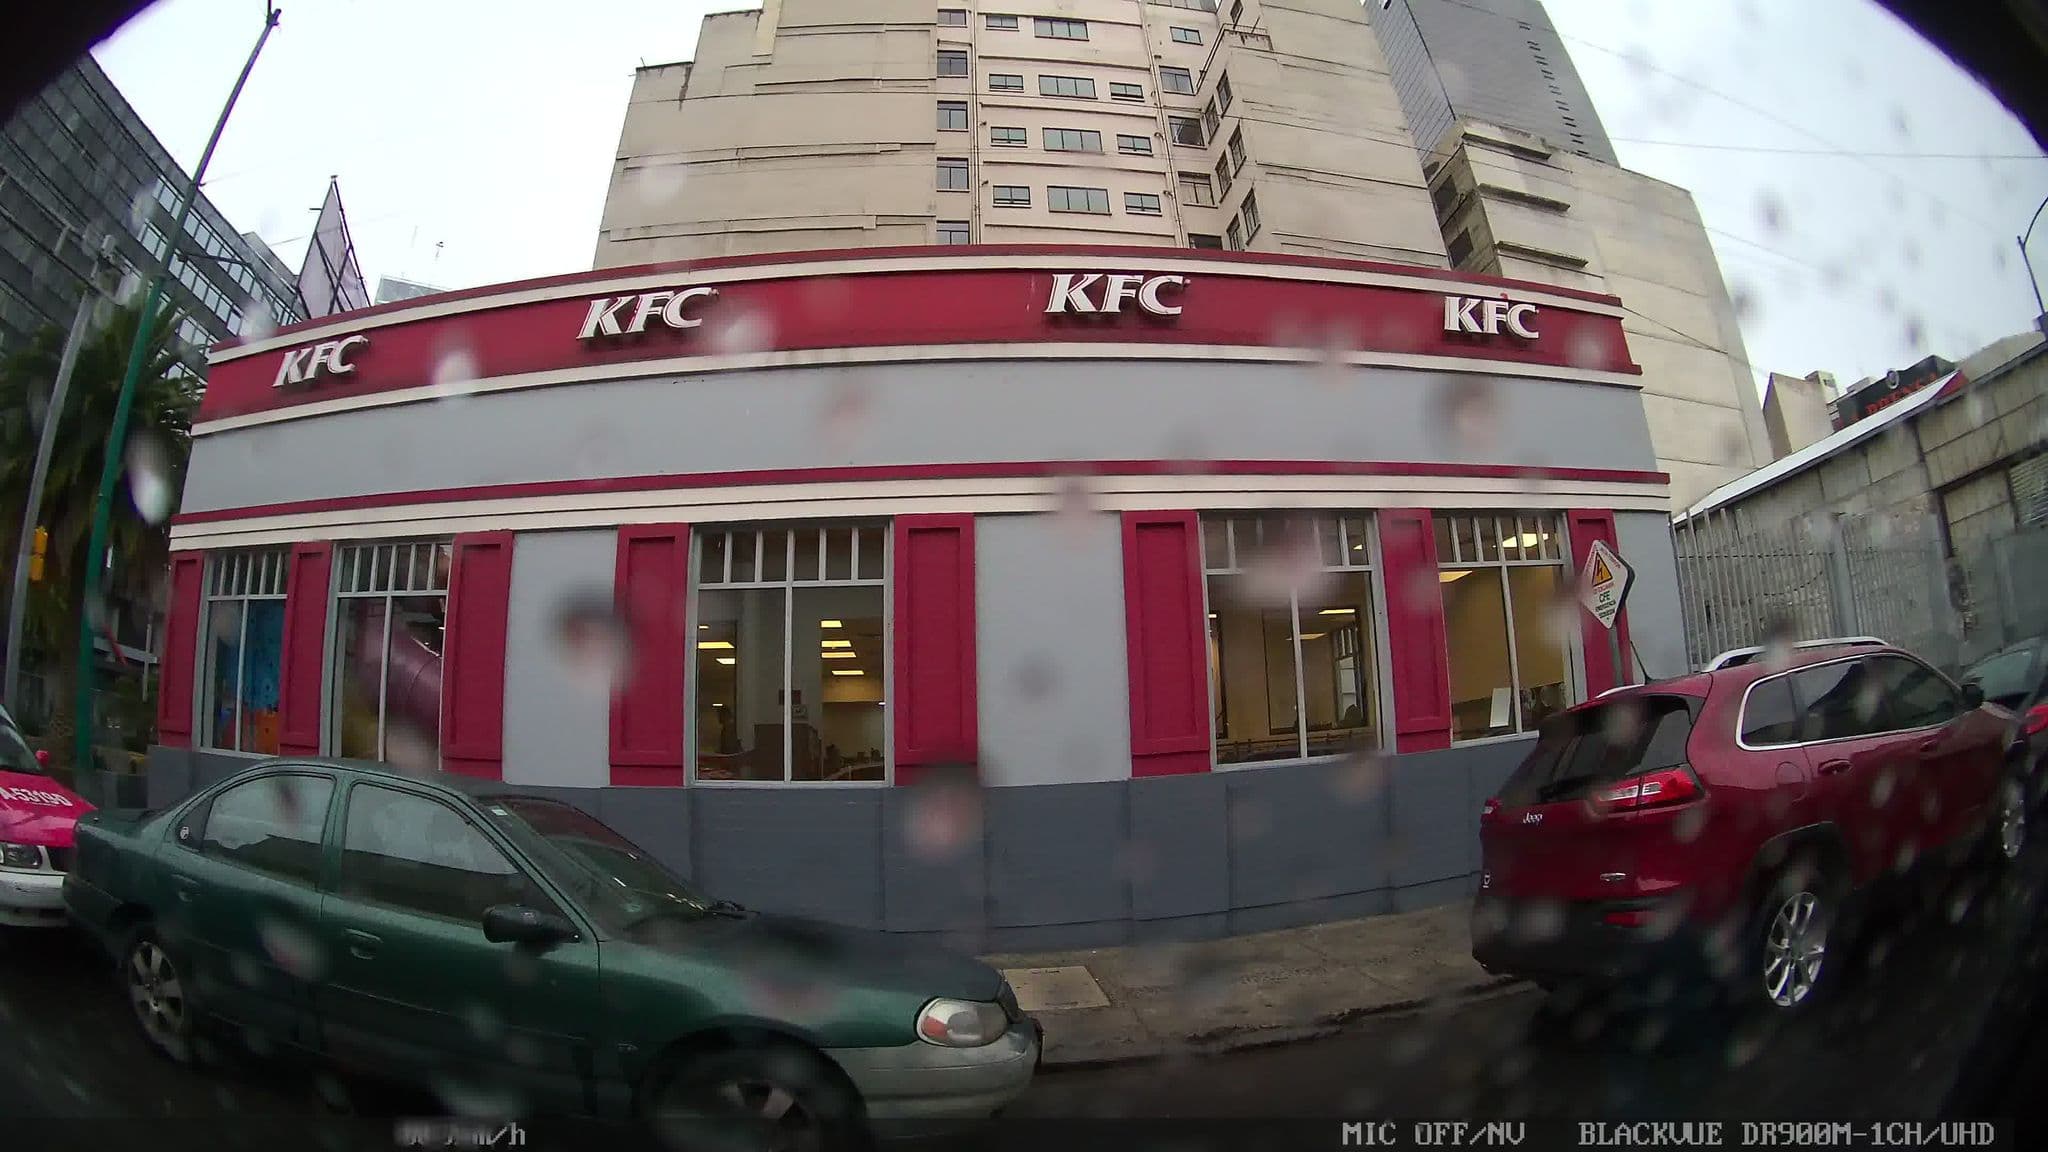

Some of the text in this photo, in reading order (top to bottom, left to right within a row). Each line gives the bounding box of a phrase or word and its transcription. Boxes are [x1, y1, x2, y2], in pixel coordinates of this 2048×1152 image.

[576, 287, 712, 339] KFC
[1043, 274, 1184, 315] KFC
[1444, 296, 1539, 338] KFC
[272, 335, 365, 387] KFC
[1523, 812, 1543, 826] Jeep
